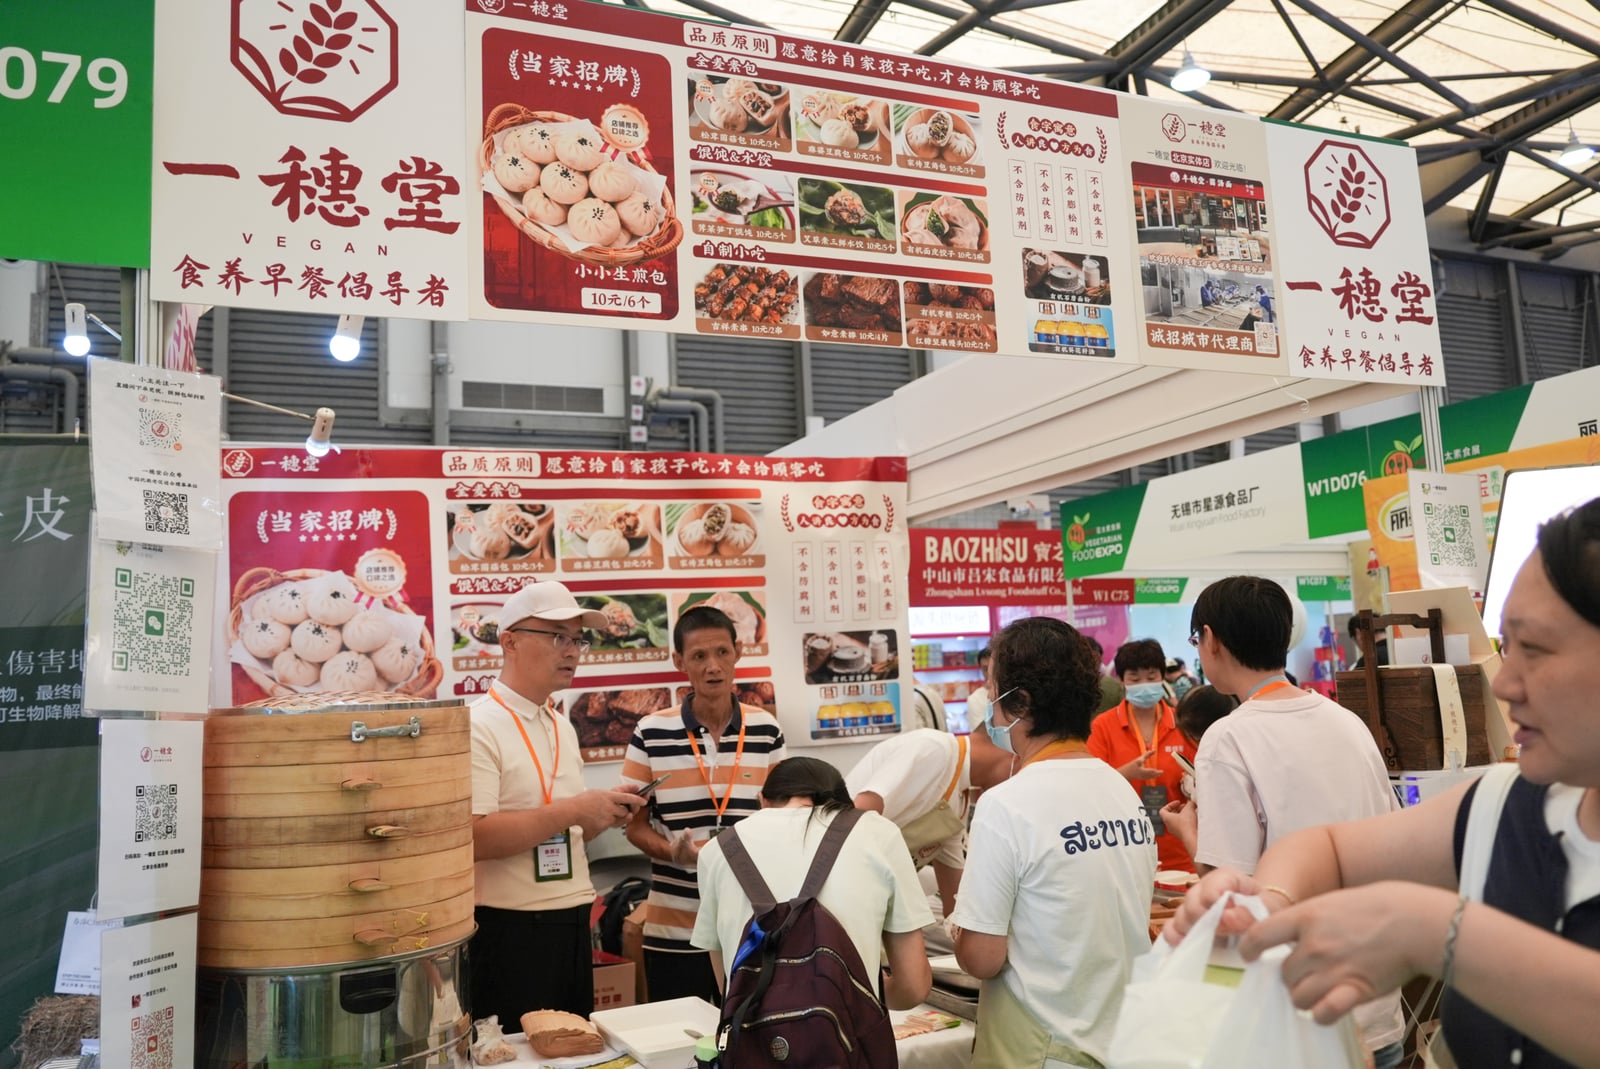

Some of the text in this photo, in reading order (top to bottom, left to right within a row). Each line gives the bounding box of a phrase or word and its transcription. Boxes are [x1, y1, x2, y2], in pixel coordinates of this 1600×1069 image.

[513, 0, 569, 20] 一穗堂
[688, 28, 770, 54] 品质原则
[0, 46, 129, 109] 079
[521, 51, 629, 88] 当家招牌
[693, 54, 759, 77] 全麦素包
[1187, 121, 1227, 138] 一穗堂
[697, 146, 773, 168] 馄饨&水饺
[1172, 152, 1211, 168] 北京实体店
[162, 145, 461, 235] 一穗堂
[1012, 164, 1028, 232] 不含防腐剂
[1039, 168, 1054, 235] 不含改良剂
[1064, 172, 1080, 237] 不含膨松剂
[1090, 176, 1104, 240] 不含抗生素
[242, 232, 389, 257] VEGAN
[703, 242, 766, 261] 自制小吃
[172, 253, 450, 309] 食养早餐倡导者
[574, 263, 668, 286] 小小生煎包
[591, 292, 652, 311] 10元/6个
[1285, 267, 1435, 326] 一穗堂
[1149, 327, 1253, 352] 诚招城市代理商
[1327, 328, 1400, 343] VEGAN
[1298, 344, 1435, 377] 食养早餐倡导者
[260, 454, 321, 473] 一穗堂
[448, 455, 534, 473] 品质原则
[454, 482, 522, 498] 全麦素包
[1307, 470, 1368, 497] W1D076
[1171, 486, 1260, 519] 无锡市星源食品厂
[270, 508, 384, 533] 当家招牌
[925, 536, 1029, 563] BAOZHISU
[1085, 534, 1122, 548] VEGETARIAN
[923, 567, 1084, 584] 中山市吕宋食品有限公
[925, 587, 974, 598] Zhongshan
